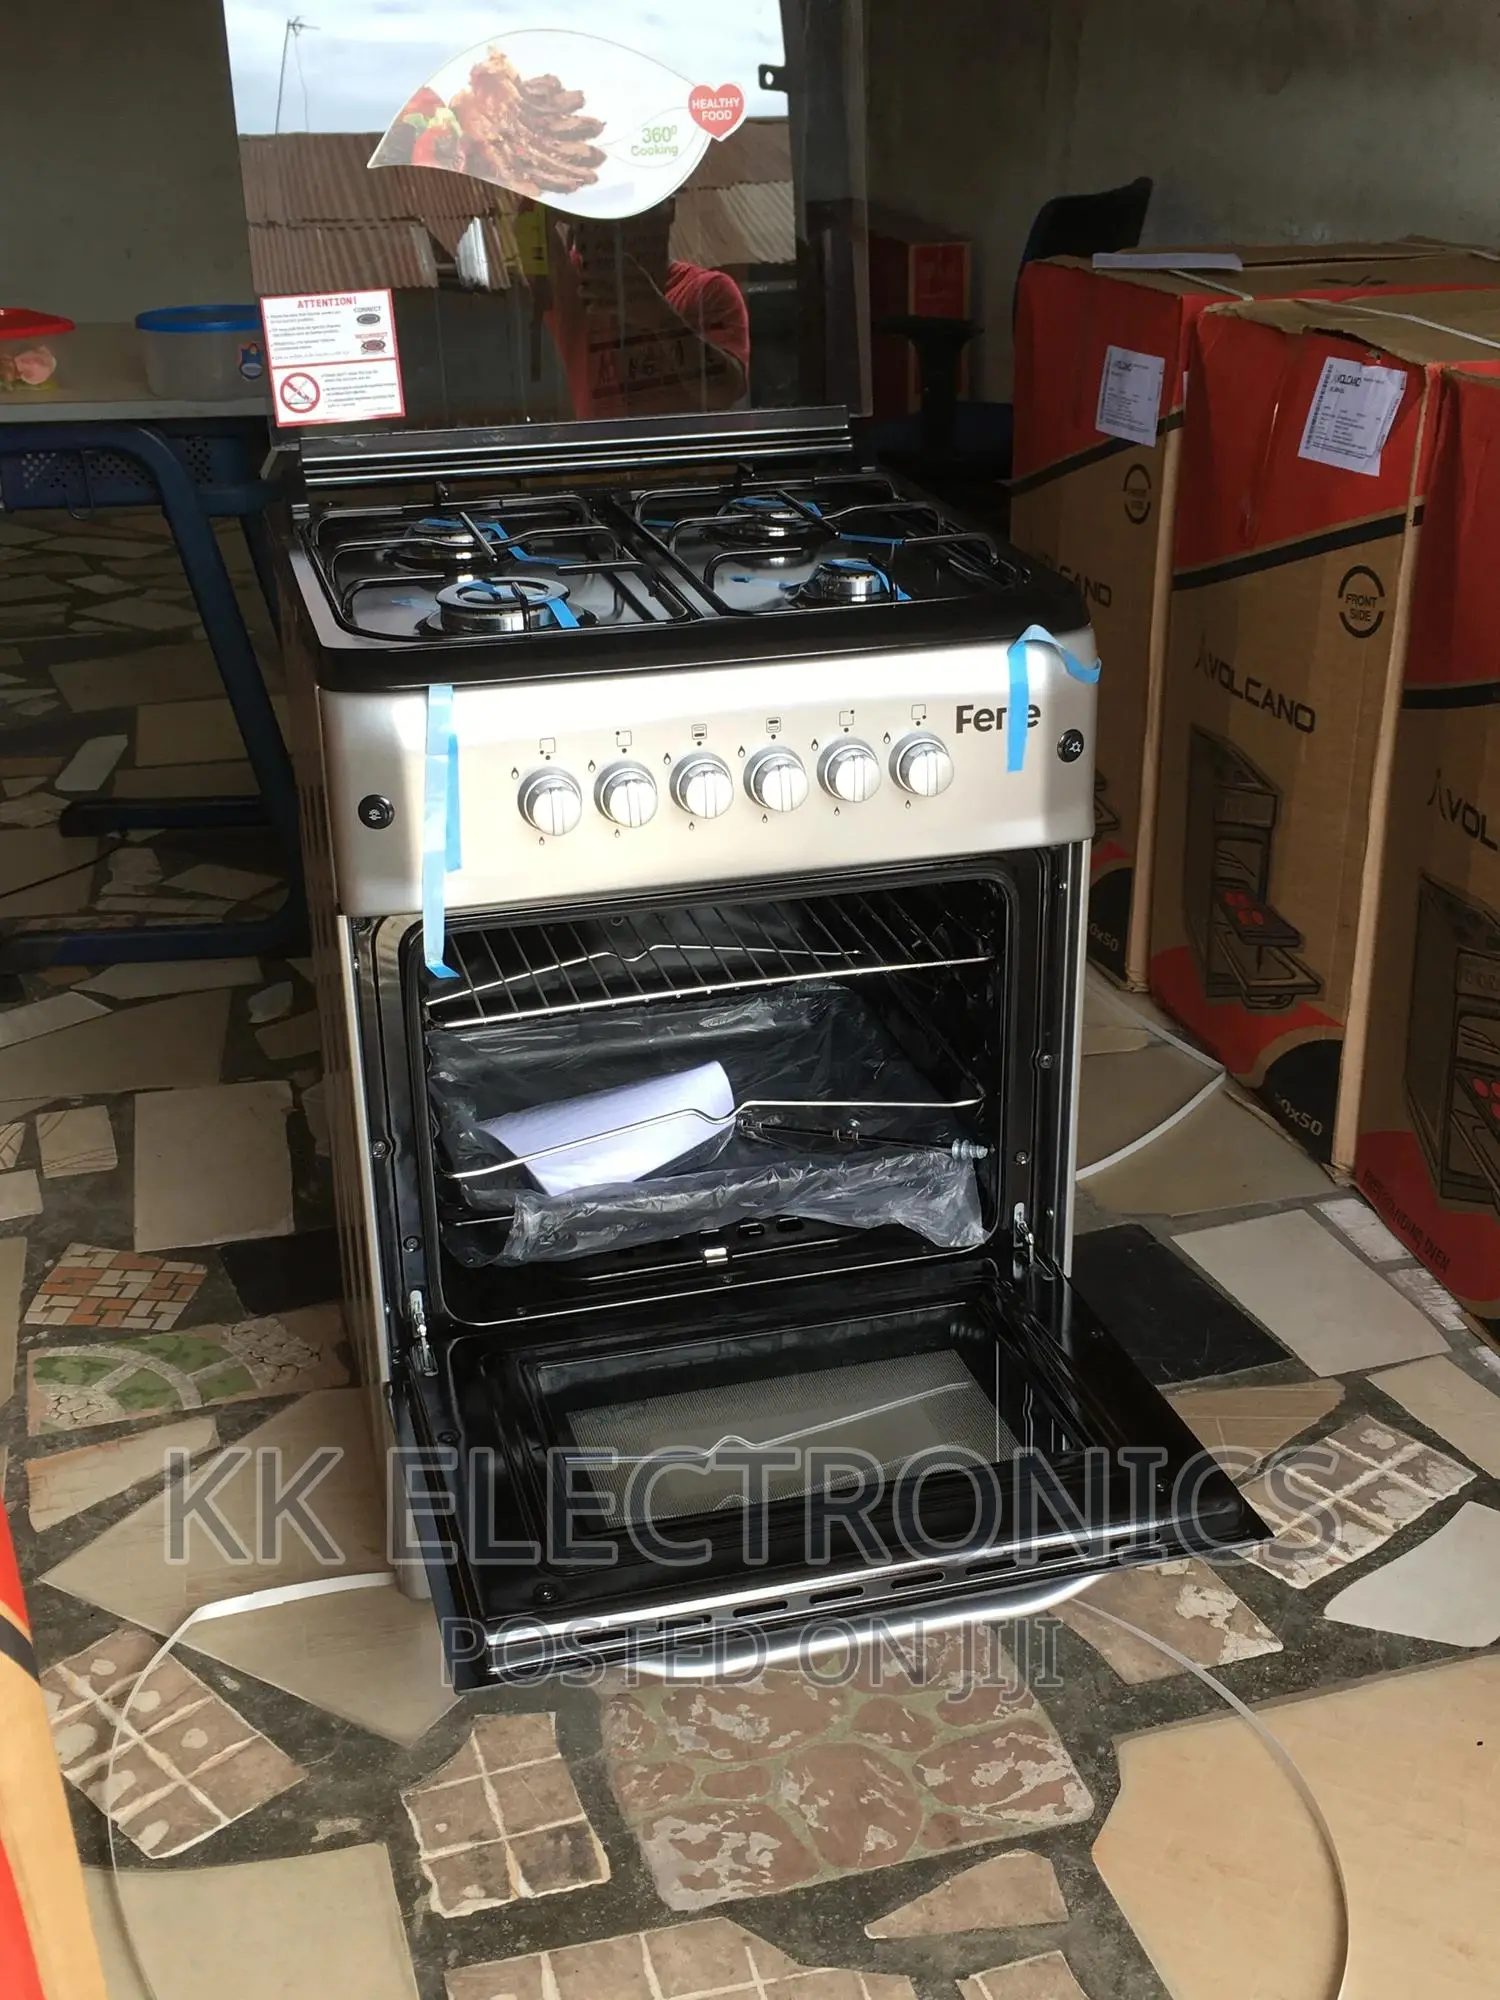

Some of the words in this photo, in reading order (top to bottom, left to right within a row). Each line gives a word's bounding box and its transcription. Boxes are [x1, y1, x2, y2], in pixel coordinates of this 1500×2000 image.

[691, 97, 740, 109] HEALTHY
[701, 110, 733, 121] FOOD
[631, 144, 679, 157] Cooking
[297, 296, 357, 309] ATTENTION!
[1345, 593, 1379, 608] FRONT
[1349, 608, 1371, 622] SIDE
[956, 704, 1041, 734] Fere
[1088, 922, 1119, 952] 0x50
